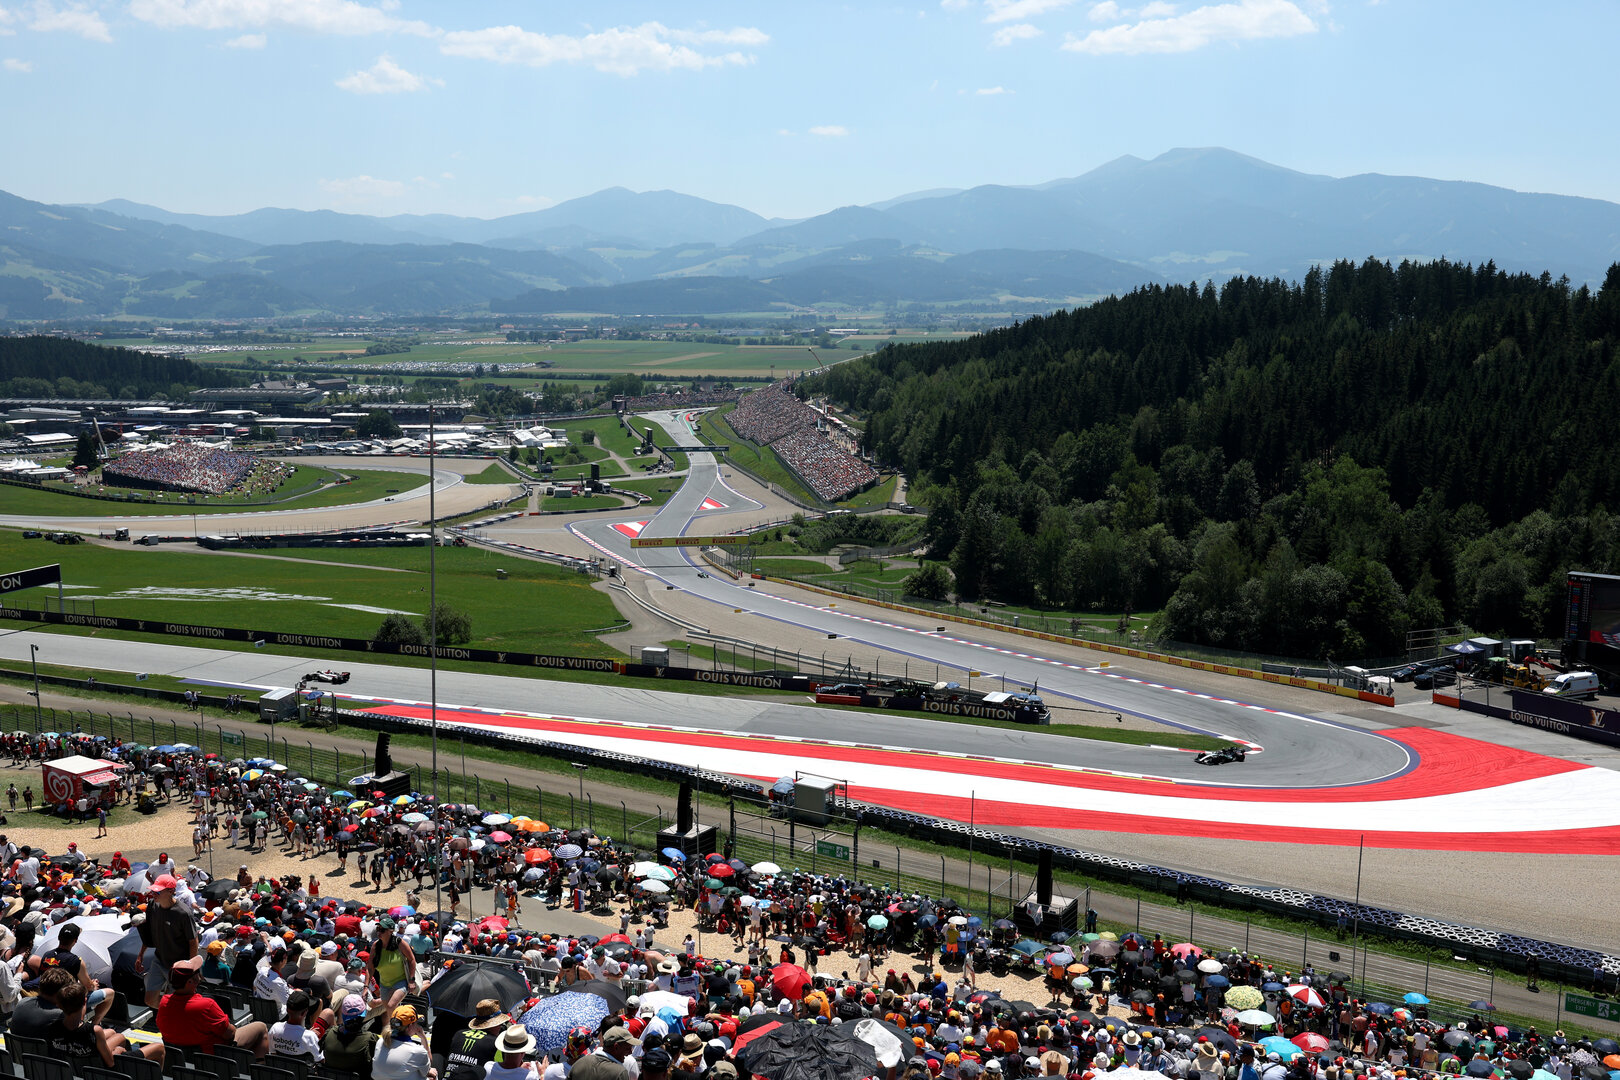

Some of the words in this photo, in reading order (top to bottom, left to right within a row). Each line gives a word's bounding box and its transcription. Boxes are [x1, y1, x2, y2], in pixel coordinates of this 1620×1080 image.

[2, 575, 21, 589] ON
[65, 615, 86, 624] LOUIS
[87, 616, 118, 627] VUITTON
[166, 624, 189, 634] LOUIS
[190, 626, 225, 637] VUITTON
[277, 634, 303, 645] LOUIS
[304, 636, 342, 648] VUITTON
[400, 644, 428, 655] LOUIS
[535, 655, 565, 667] LOUIS
[567, 658, 613, 670] VUITTON
[696, 671, 730, 683] LOUIS
[732, 675, 781, 688] VUITTON
[1318, 683, 1337, 693] PIRELLI
[923, 701, 960, 714] LOUIS
[962, 704, 1017, 720] VUITTON
[1510, 711, 1534, 725] LOUIS
[1534, 718, 1570, 733] VUITTON
[1568, 997, 1595, 1007] EMERGENCY
[462, 1029, 488, 1039] 46
[273, 1036, 301, 1048] Nobody's
[453, 1053, 478, 1066] YAMAHA
